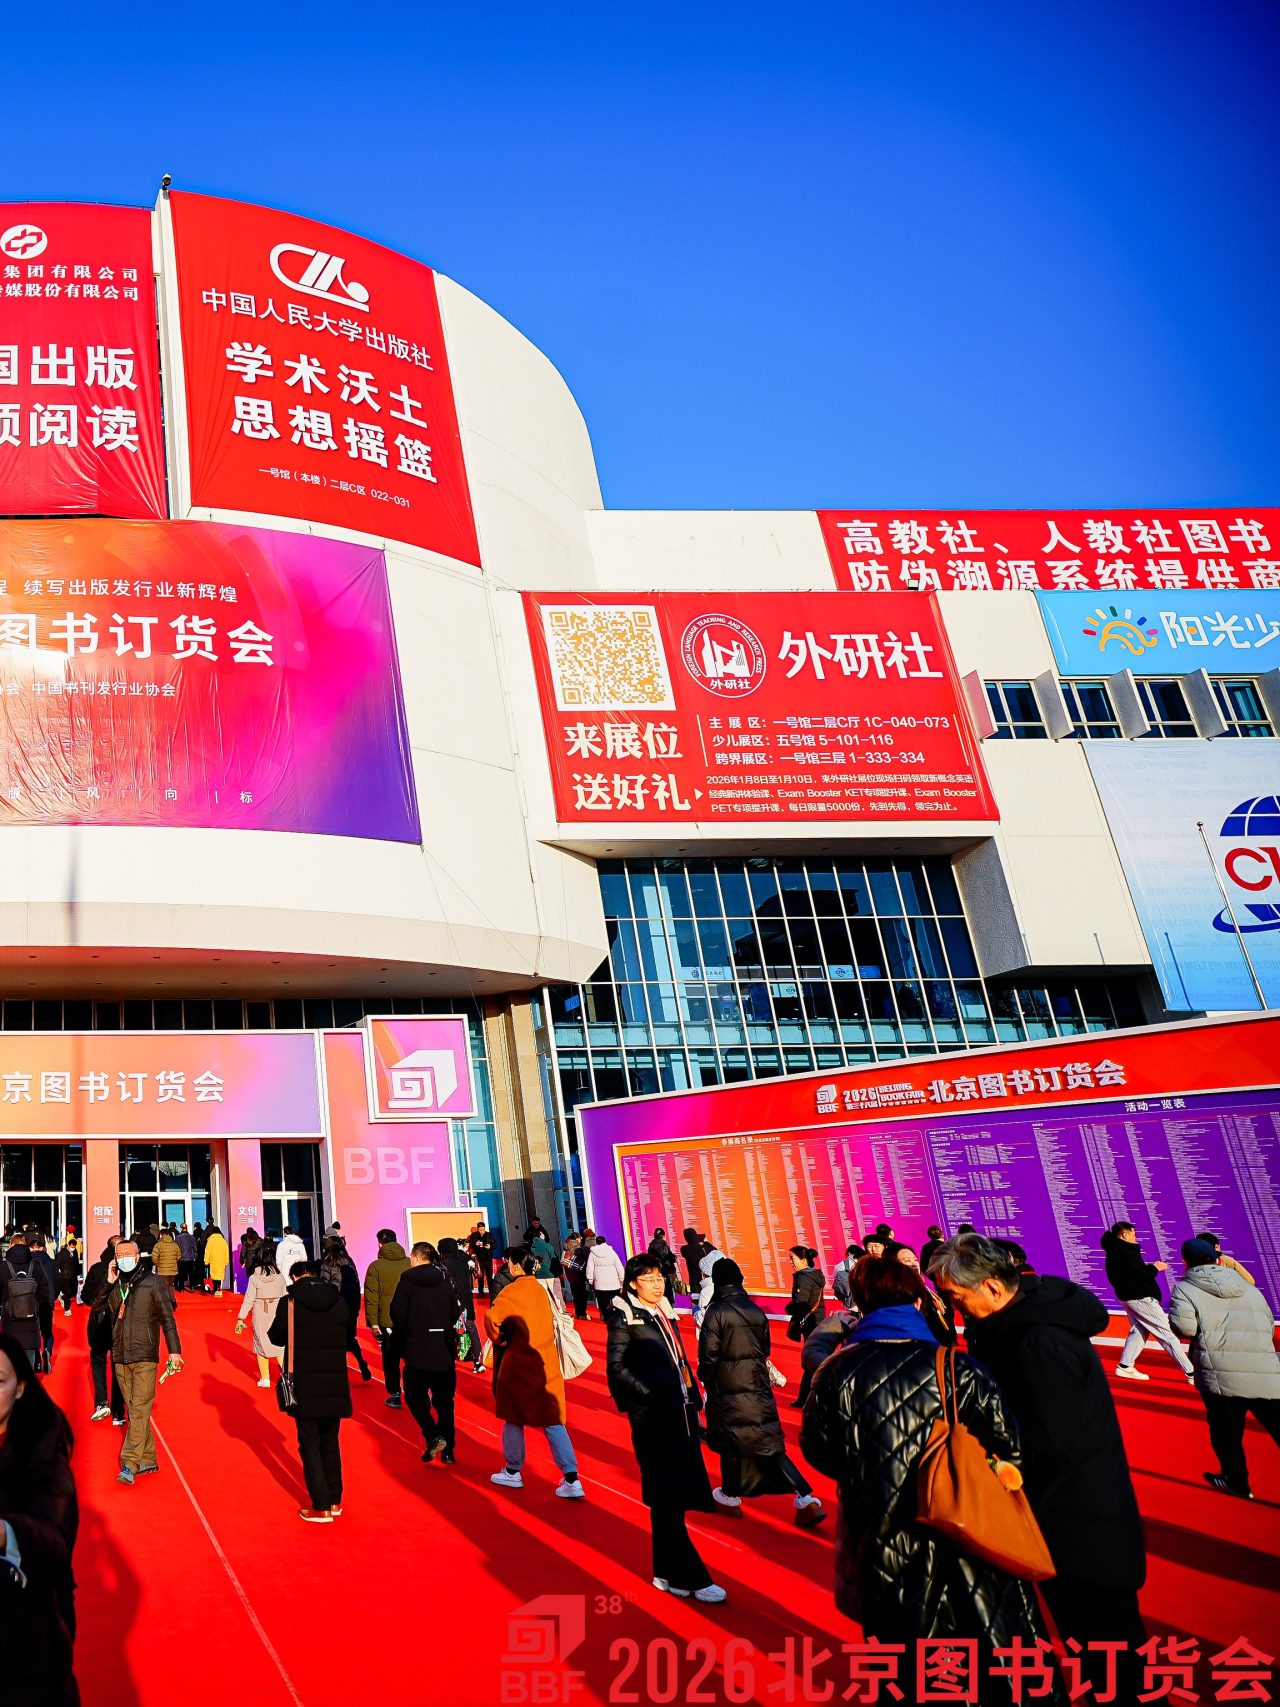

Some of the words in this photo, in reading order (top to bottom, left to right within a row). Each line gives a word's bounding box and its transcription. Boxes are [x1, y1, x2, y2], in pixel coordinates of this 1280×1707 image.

[201, 288, 434, 371] 中国人民大学出版社
[225, 341, 428, 429] 学术沃土
[231, 395, 438, 484] 思想摇篮
[24, 578, 239, 603] 续写出版发行业新辉煌
[777, 629, 945, 681] 外研社
[31, 681, 177, 698] 中国书刊发行业协会
[710, 678, 753, 690] 外研社
[864, 716, 950, 728] 1C-040-073
[563, 721, 683, 761] 来展位
[819, 734, 894, 746] 5-101-116
[849, 752, 926, 764] 1-333-334
[572, 772, 691, 814] 送好礼
[777, 789, 804, 798] Exam
[807, 789, 842, 798] Booster
[914, 789, 941, 797] Exam
[944, 788, 977, 797] Booster
[879, 1082, 913, 1093] BEIJING
[928, 1059, 1128, 1104] 北京图书订货会
[842, 1086, 877, 1104] 2026
[880, 1092, 905, 1102] BOOK
[905, 1089, 925, 1099] FAIR
[817, 1102, 839, 1114] BBF
[1124, 1098, 1187, 1112] 活动一览表
[342, 1146, 436, 1186] BBF
[237, 1205, 258, 1217] 文创
